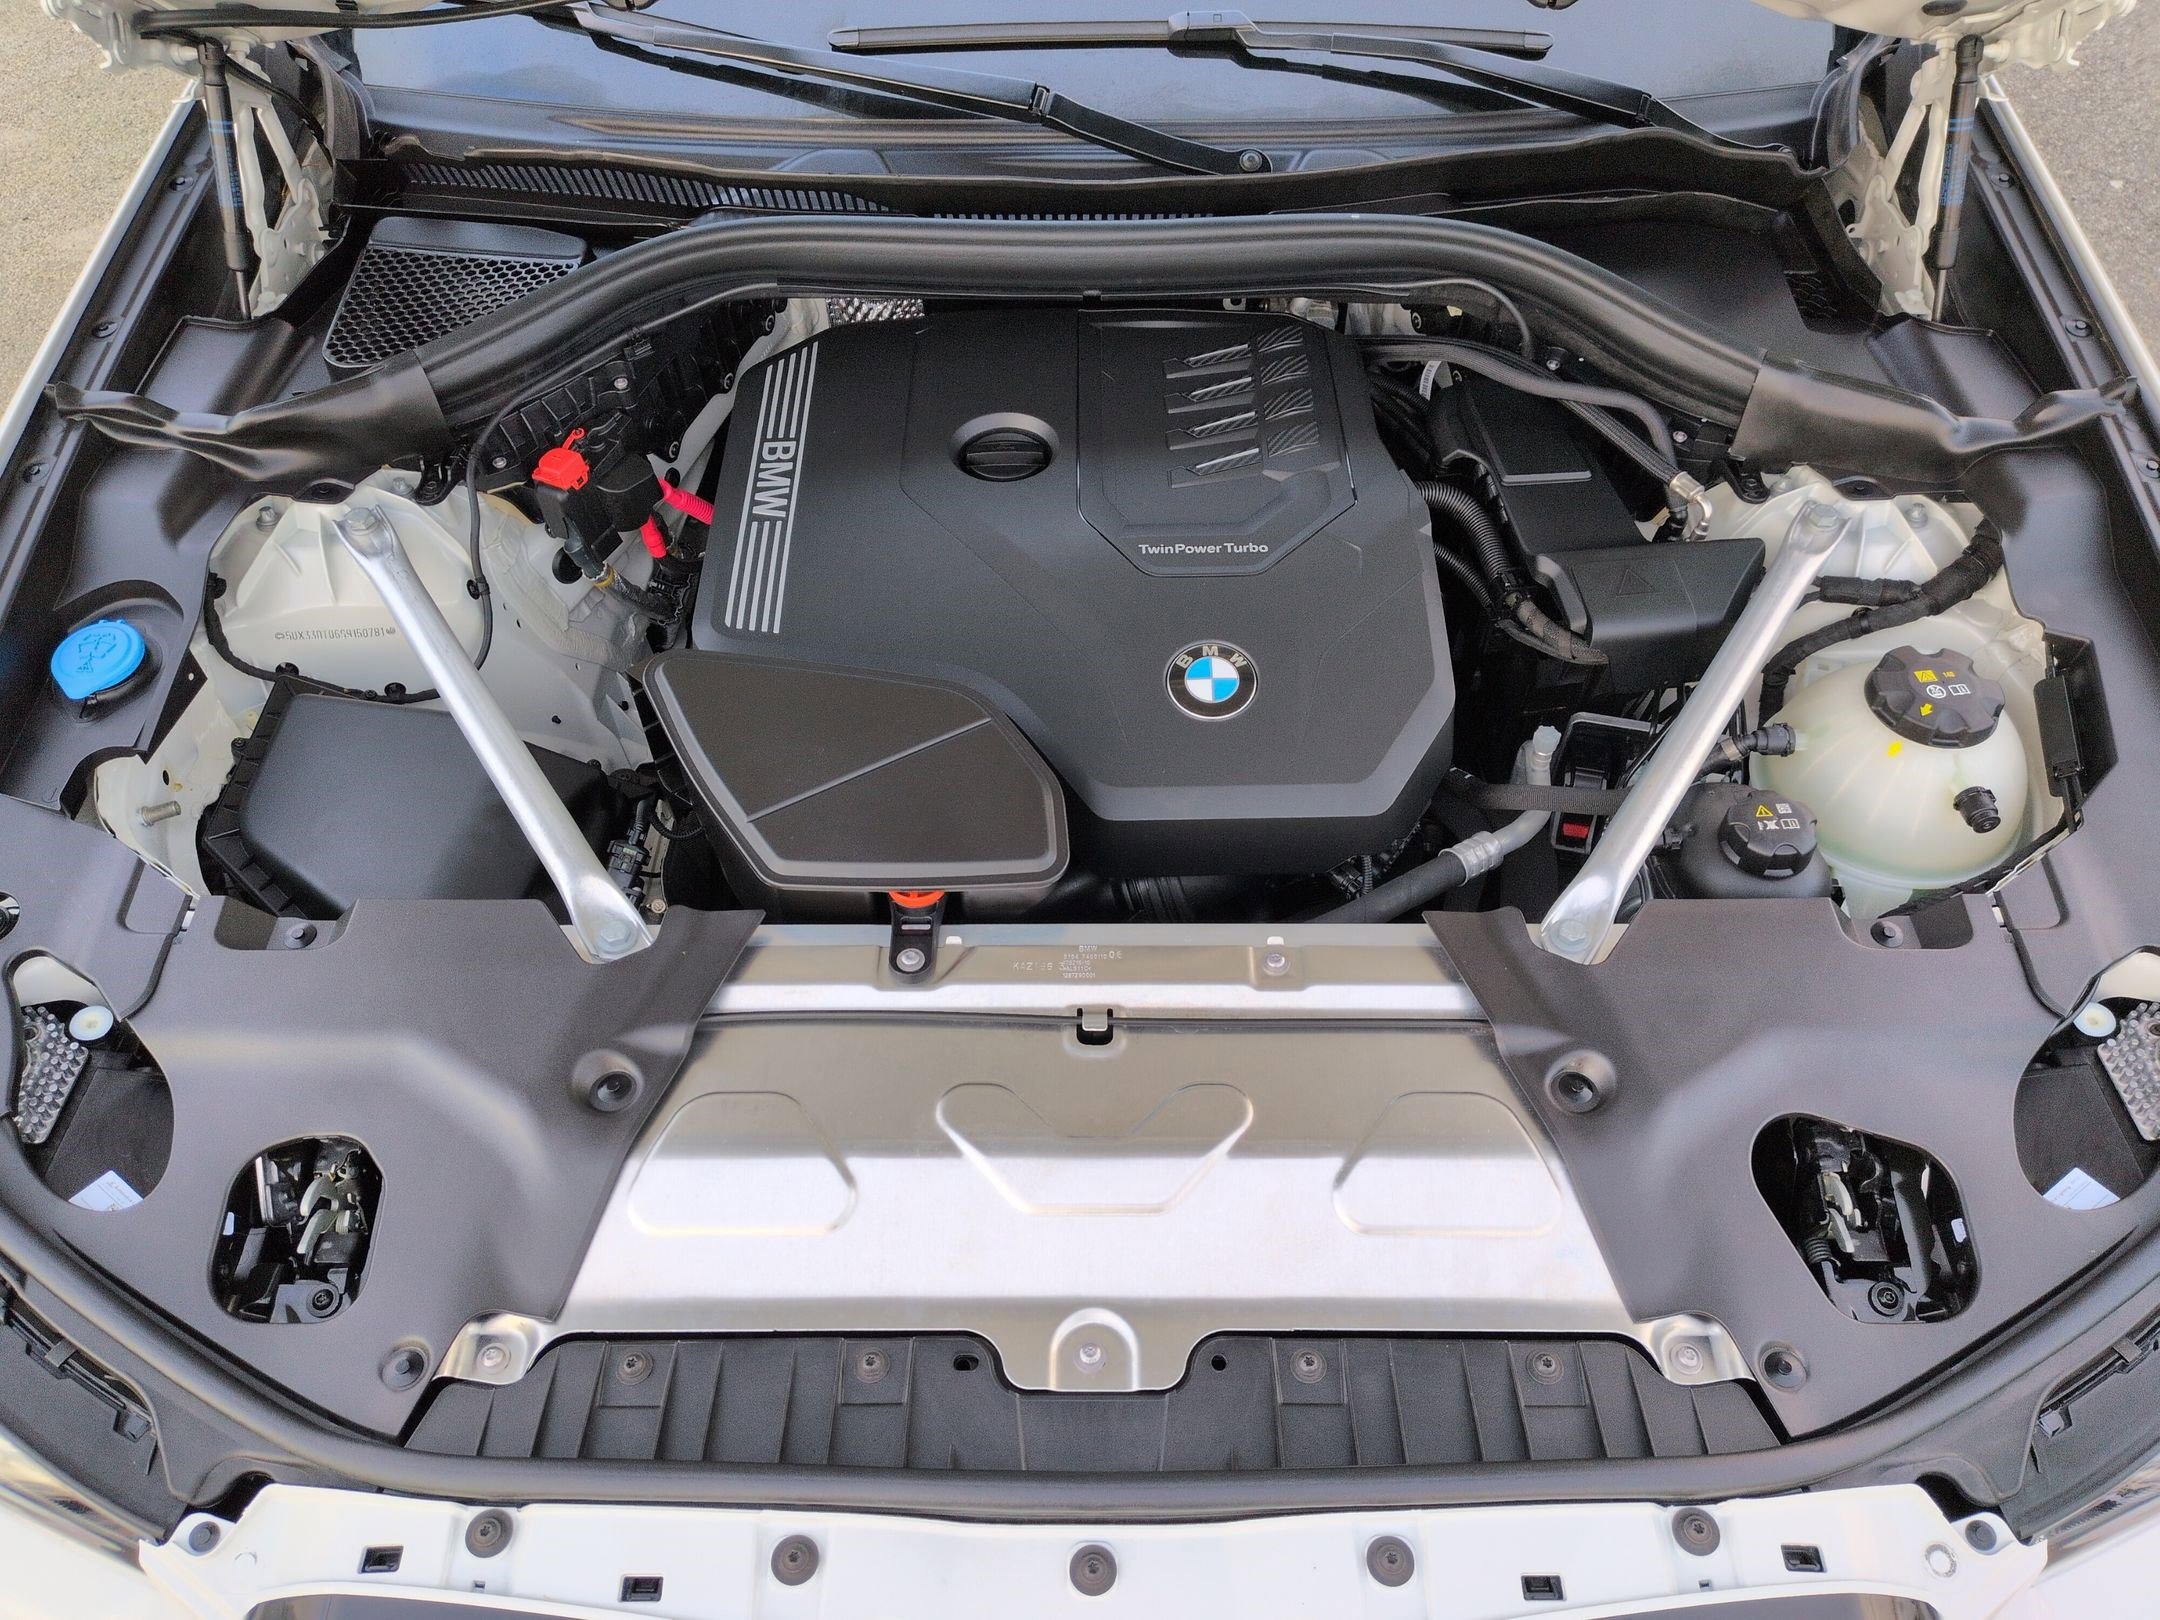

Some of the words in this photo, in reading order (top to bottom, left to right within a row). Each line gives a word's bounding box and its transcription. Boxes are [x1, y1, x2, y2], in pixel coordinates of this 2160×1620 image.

[752, 441, 797, 517] BMW
[1223, 542, 1269, 553] Turbo
[1176, 645, 1248, 669] BMW
